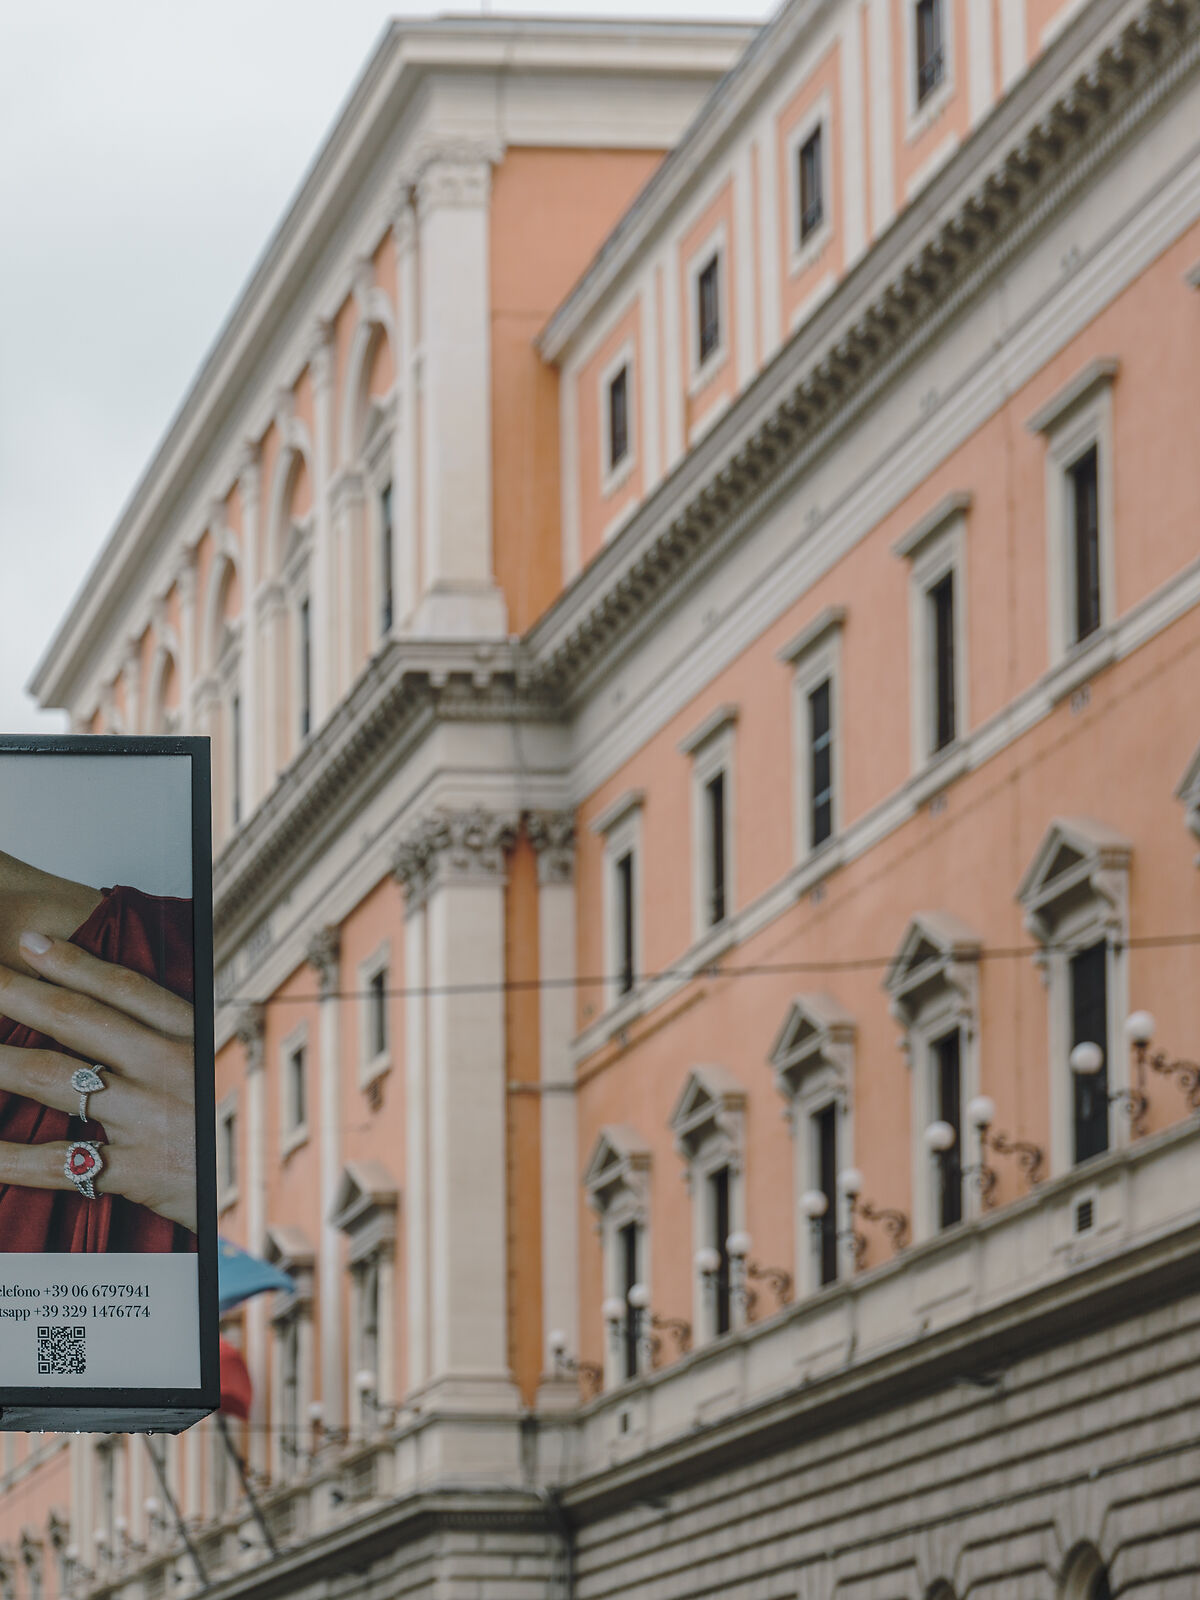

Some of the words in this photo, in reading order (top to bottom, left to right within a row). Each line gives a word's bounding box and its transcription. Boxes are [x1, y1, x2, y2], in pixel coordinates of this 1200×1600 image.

[43, 1284, 69, 1298] +39
[71, 1284, 89, 1298] 06
[91, 1284, 150, 1298] 6797941
[33, 1305, 59, 1318] +39
[62, 1305, 87, 1318] 329
[92, 1305, 150, 1318] 1476774
